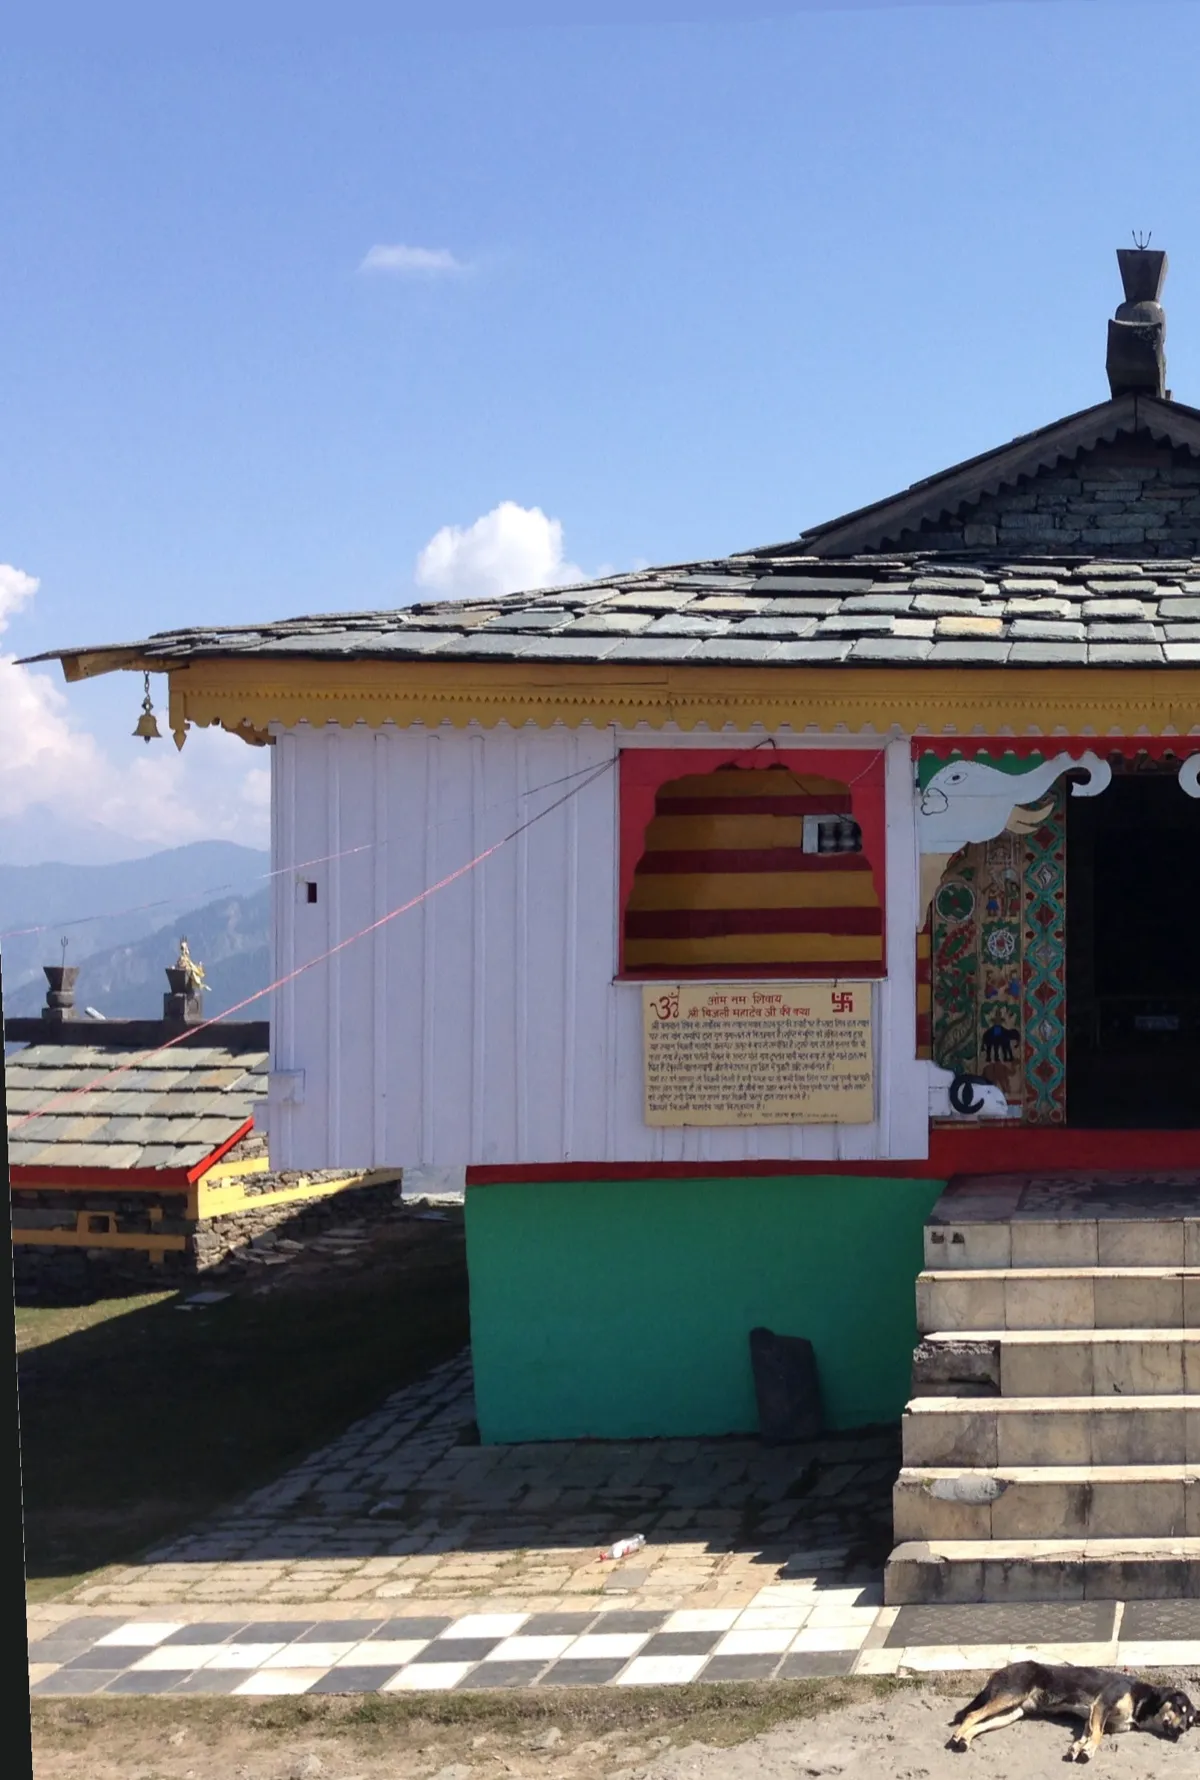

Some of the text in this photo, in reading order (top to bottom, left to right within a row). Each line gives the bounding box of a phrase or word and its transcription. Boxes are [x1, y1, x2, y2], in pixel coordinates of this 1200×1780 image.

[752, 991, 783, 1004] शिवाय
[687, 1004, 811, 1019] श्री बिजली महादेव जी की कथा
